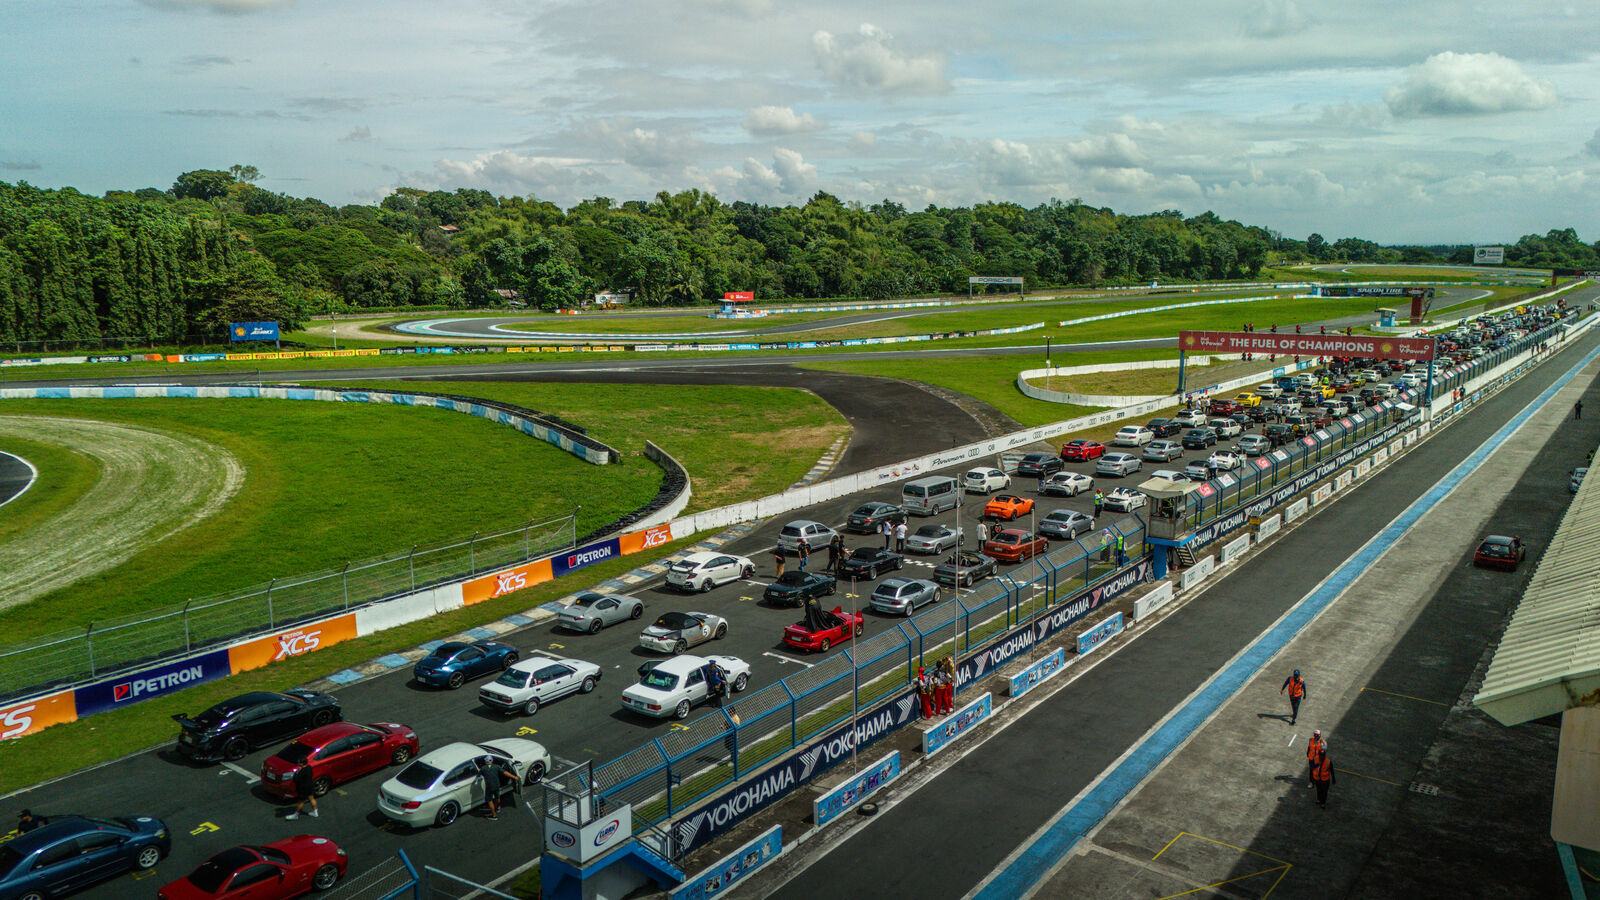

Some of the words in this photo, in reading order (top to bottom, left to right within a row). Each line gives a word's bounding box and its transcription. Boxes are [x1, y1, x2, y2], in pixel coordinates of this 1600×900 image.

[1230, 337, 1249, 347] THE
[1252, 339, 1277, 349] FUEL
[1280, 340, 1296, 350] OF
[1297, 340, 1374, 353] CHAMPIONS
[643, 530, 668, 548] XCS
[577, 546, 611, 565] PETRON
[495, 572, 527, 595] XCS
[1102, 570, 1136, 599] YOKOHAMA
[1050, 597, 1090, 630] YOKOHAMA
[275, 630, 322, 660] XCS
[990, 630, 1037, 666] YOKOHAMA
[133, 665, 203, 696] PETRON
[823, 710, 893, 763] YOKOHAMA
[706, 766, 795, 831] YOKOHAMA
